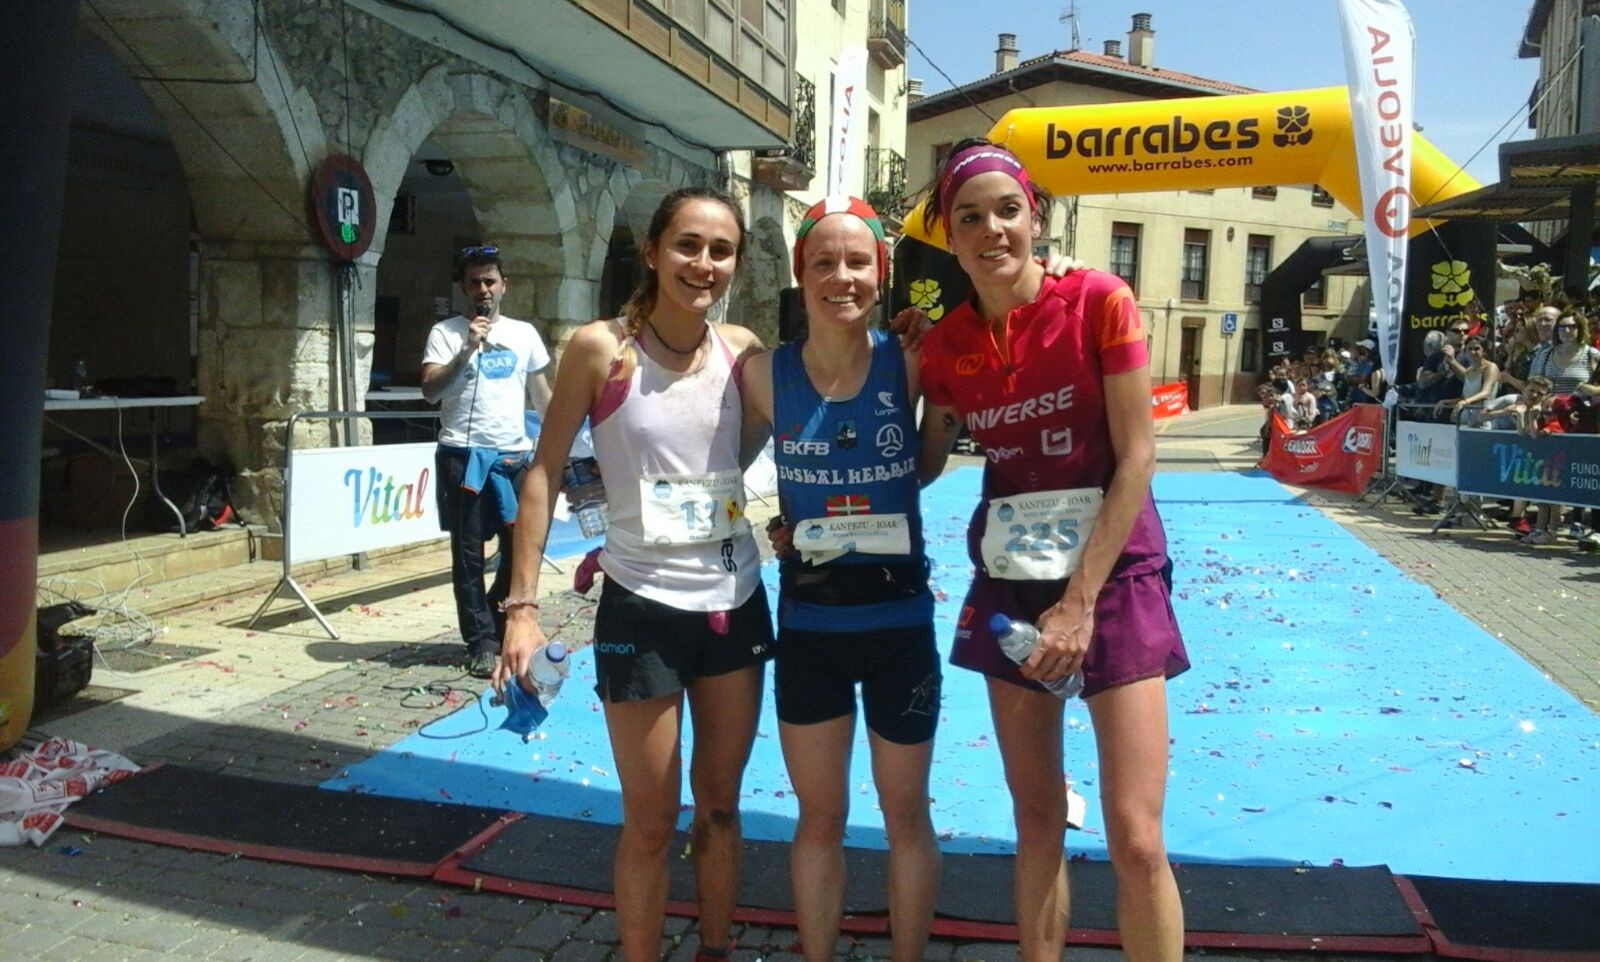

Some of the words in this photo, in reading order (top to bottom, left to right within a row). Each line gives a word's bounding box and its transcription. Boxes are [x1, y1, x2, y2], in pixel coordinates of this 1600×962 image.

[1046, 116, 1259, 159] barrabes
[1088, 155, 1252, 174] www.barrabes.com
[342, 192, 354, 220] P
[967, 384, 1074, 431] INVERSE
[783, 440, 830, 456] EKFB
[780, 465, 844, 485] EUSKAL
[1493, 443, 1566, 488] Vital
[1571, 462, 1600, 475] FUND
[1571, 476, 1600, 490] FUND
[344, 466, 429, 528] Vital
[829, 520, 869, 531] KANPEZU
[1005, 519, 1079, 552] 225
